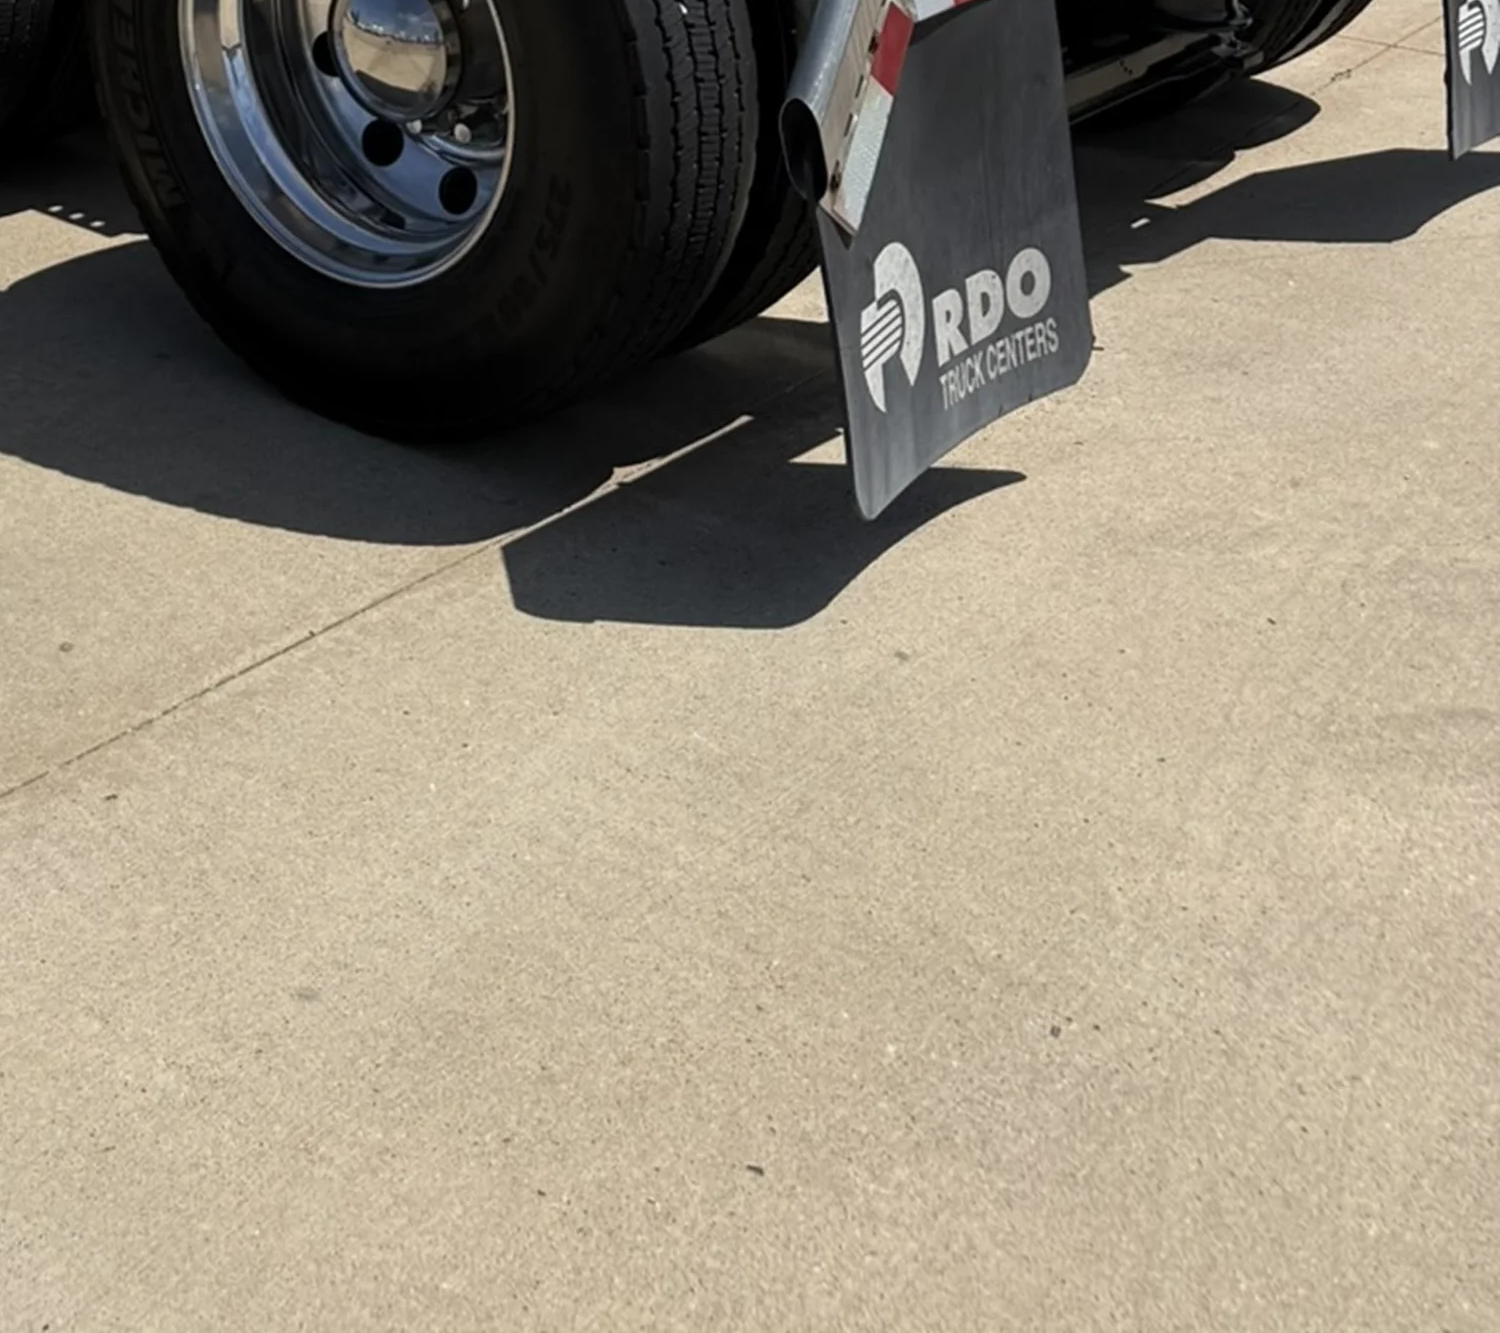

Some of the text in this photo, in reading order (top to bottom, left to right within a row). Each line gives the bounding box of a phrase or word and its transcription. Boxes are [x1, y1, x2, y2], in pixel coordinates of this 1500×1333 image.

[931, 246, 1051, 368] RDO
[938, 317, 1059, 411] TRUCK CENTERS
